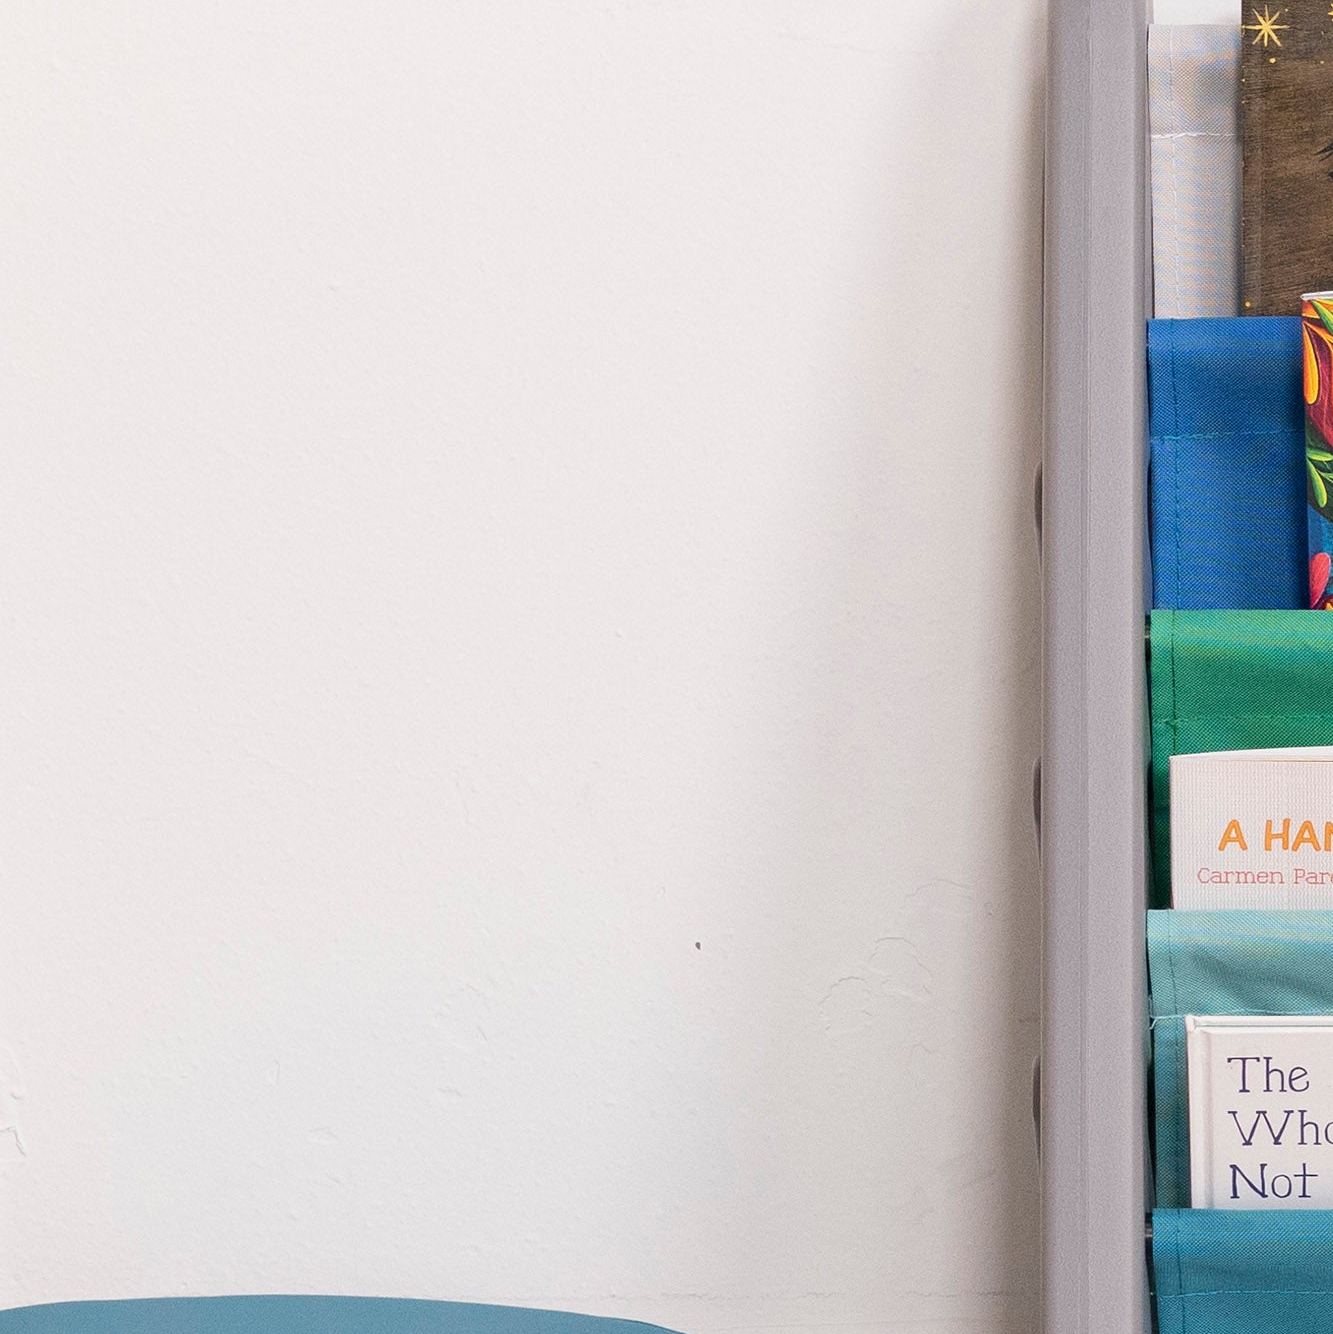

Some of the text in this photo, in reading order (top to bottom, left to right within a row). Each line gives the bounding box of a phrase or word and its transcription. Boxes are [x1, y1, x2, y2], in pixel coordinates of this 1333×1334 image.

[1218, 819, 1248, 851] A
[1197, 867, 1285, 885] Carmen
[1226, 1056, 1310, 1093] The
[1229, 1163, 1319, 1199] Not
